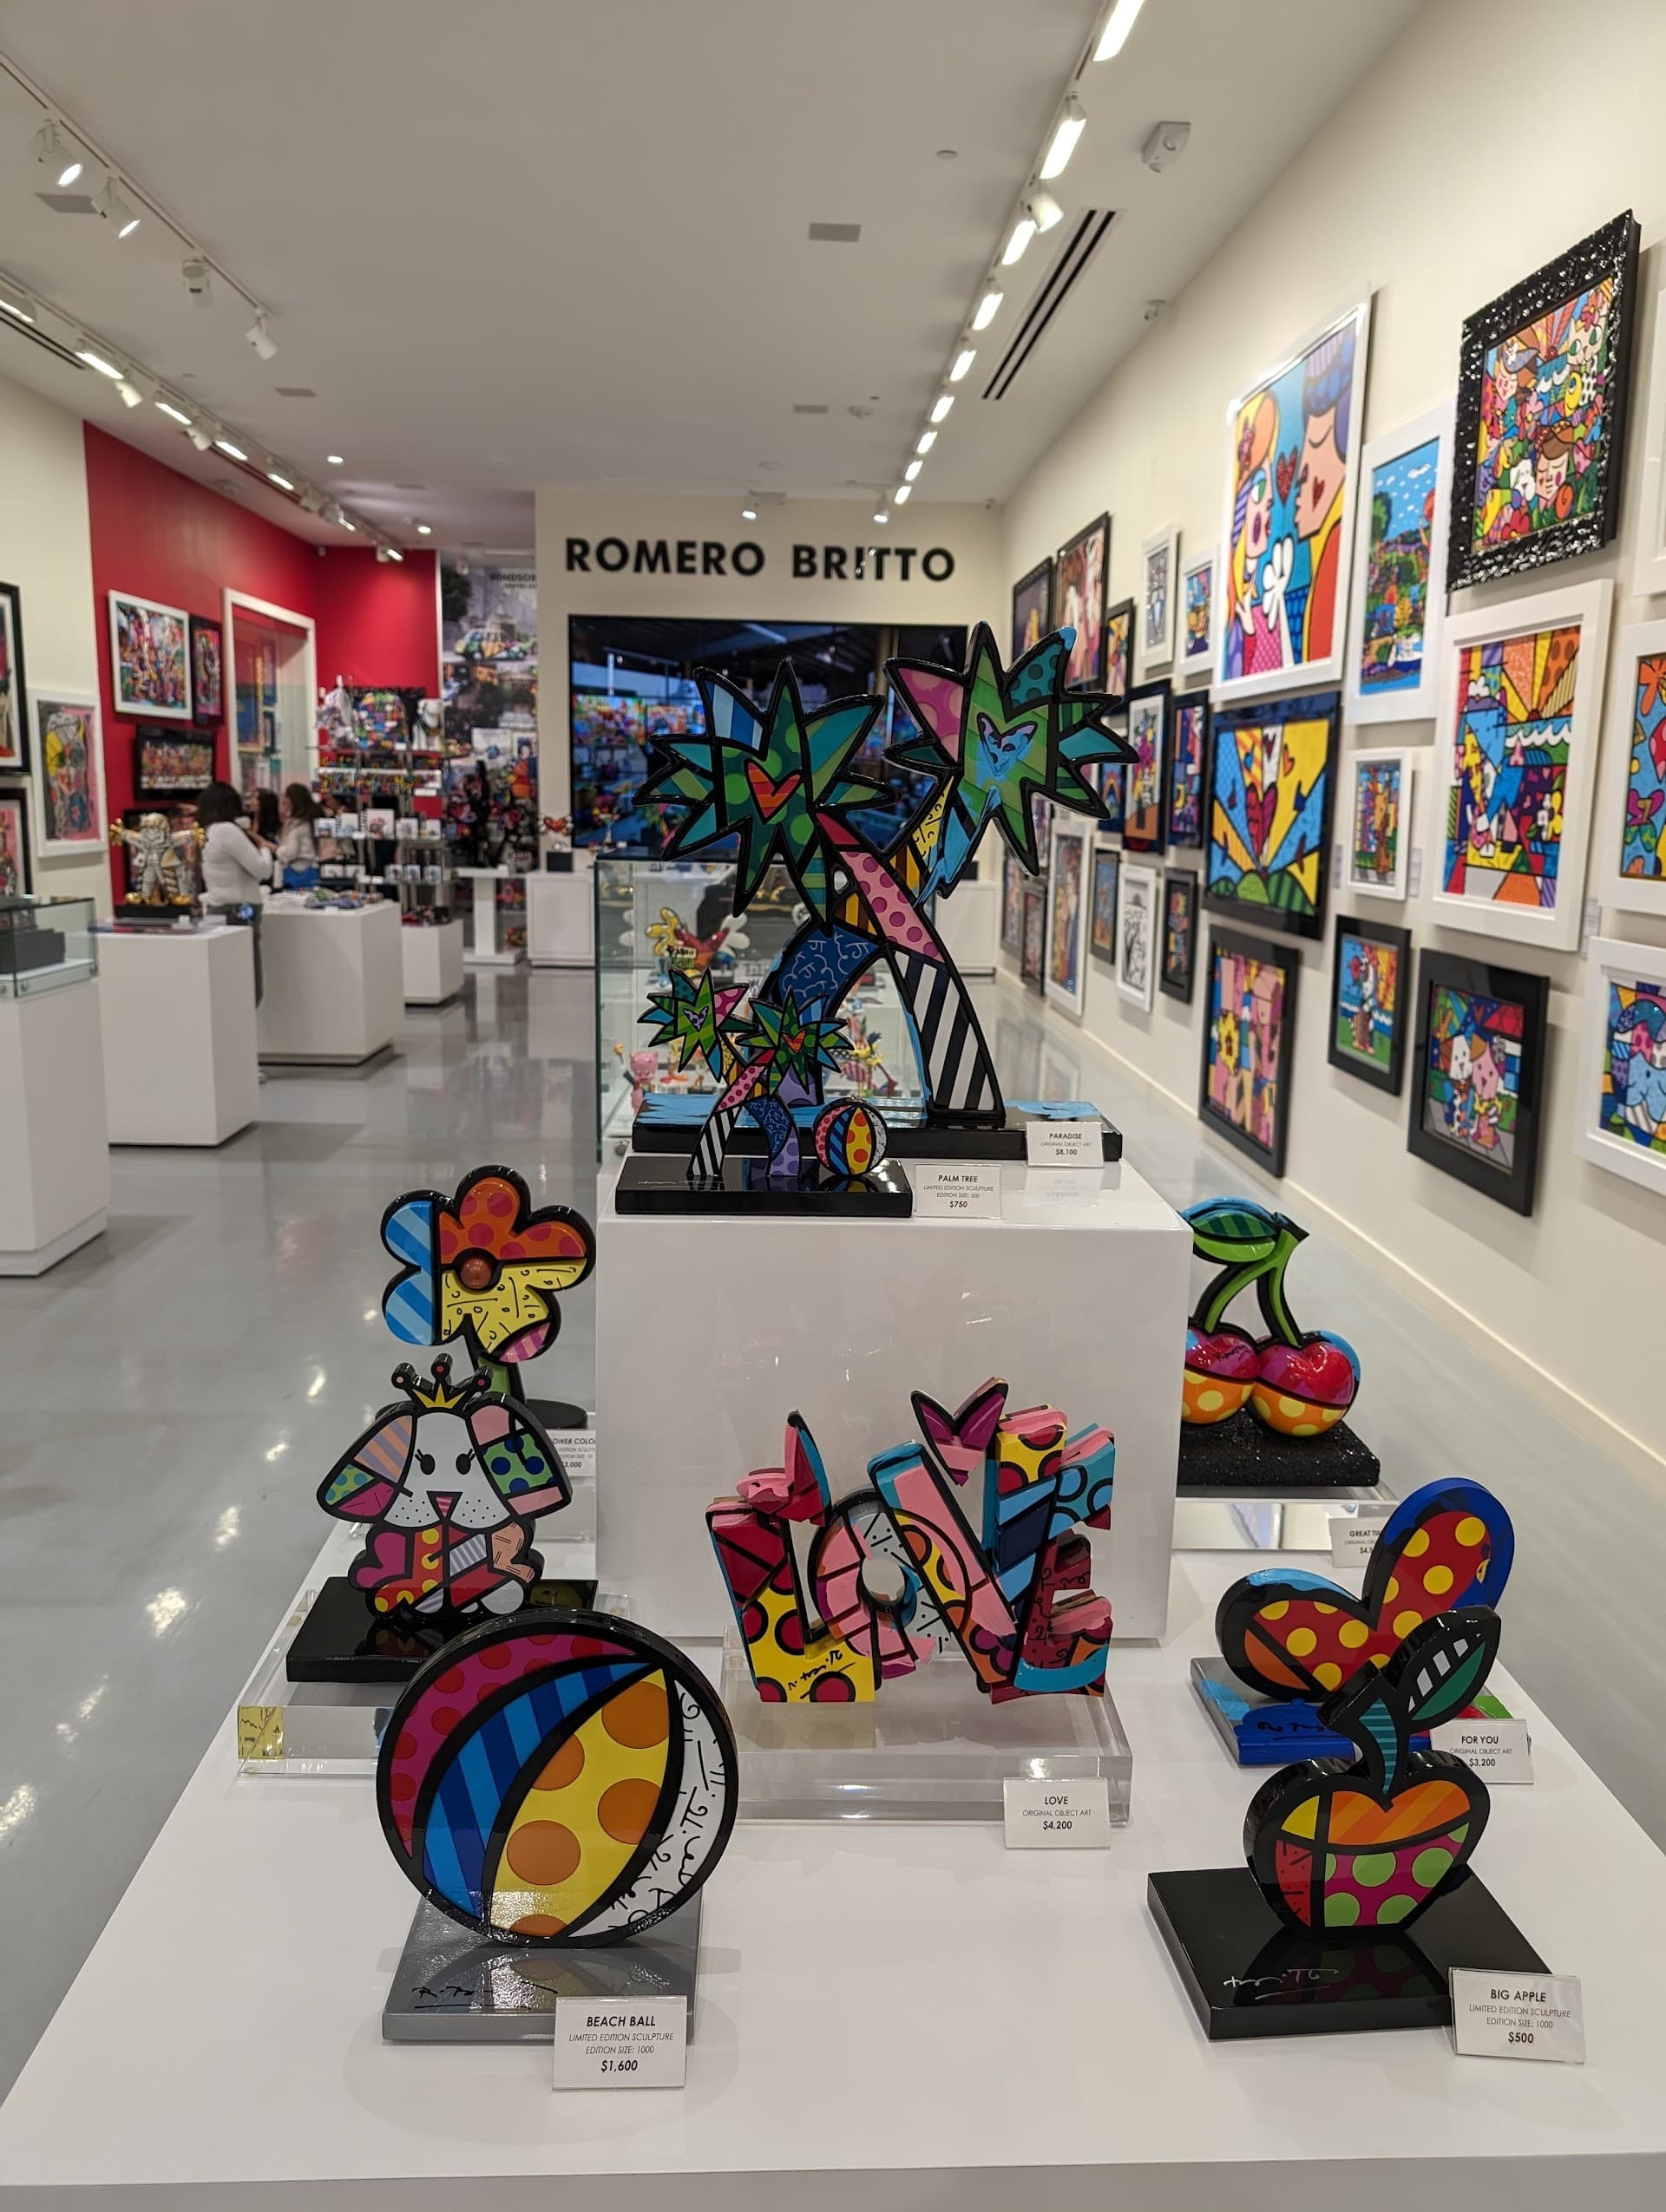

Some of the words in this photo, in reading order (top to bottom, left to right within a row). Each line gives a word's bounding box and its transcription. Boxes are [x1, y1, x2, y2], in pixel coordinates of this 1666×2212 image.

[566, 538, 765, 576] ROMERO
[792, 545, 956, 582] BRITTO
[1461, 1736, 1479, 1744] FOR
[1480, 1736, 1499, 1744] YOU
[1469, 1758, 1496, 1768] $3,200
[1045, 1796, 1069, 1805] LOVE
[1042, 1820, 1072, 1830] $4,200
[1491, 1988, 1510, 2000] BIG
[1513, 1990, 1547, 2003] APPLE
[1468, 2004, 1498, 2013] LIMITED
[1499, 2006, 1529, 2015] EDITION
[1530, 2007, 1571, 2019] SCULPTURE
[587, 2016, 626, 2027] BEACH
[629, 2015, 656, 2026] BALL
[1486, 2017, 1517, 2026] EDITION
[1518, 2019, 1534, 2027] SIZE:
[1536, 2019, 1553, 2029] 1000
[568, 2033, 598, 2042] LIMITED
[632, 2032, 674, 2041] SCULPTURE
[1507, 2032, 1534, 2044] $500
[585, 2045, 616, 2055] EDITION
[618, 2045, 634, 2054] SIZE:
[637, 2045, 655, 2054] 1000
[600, 2059, 639, 2073] $1,600
